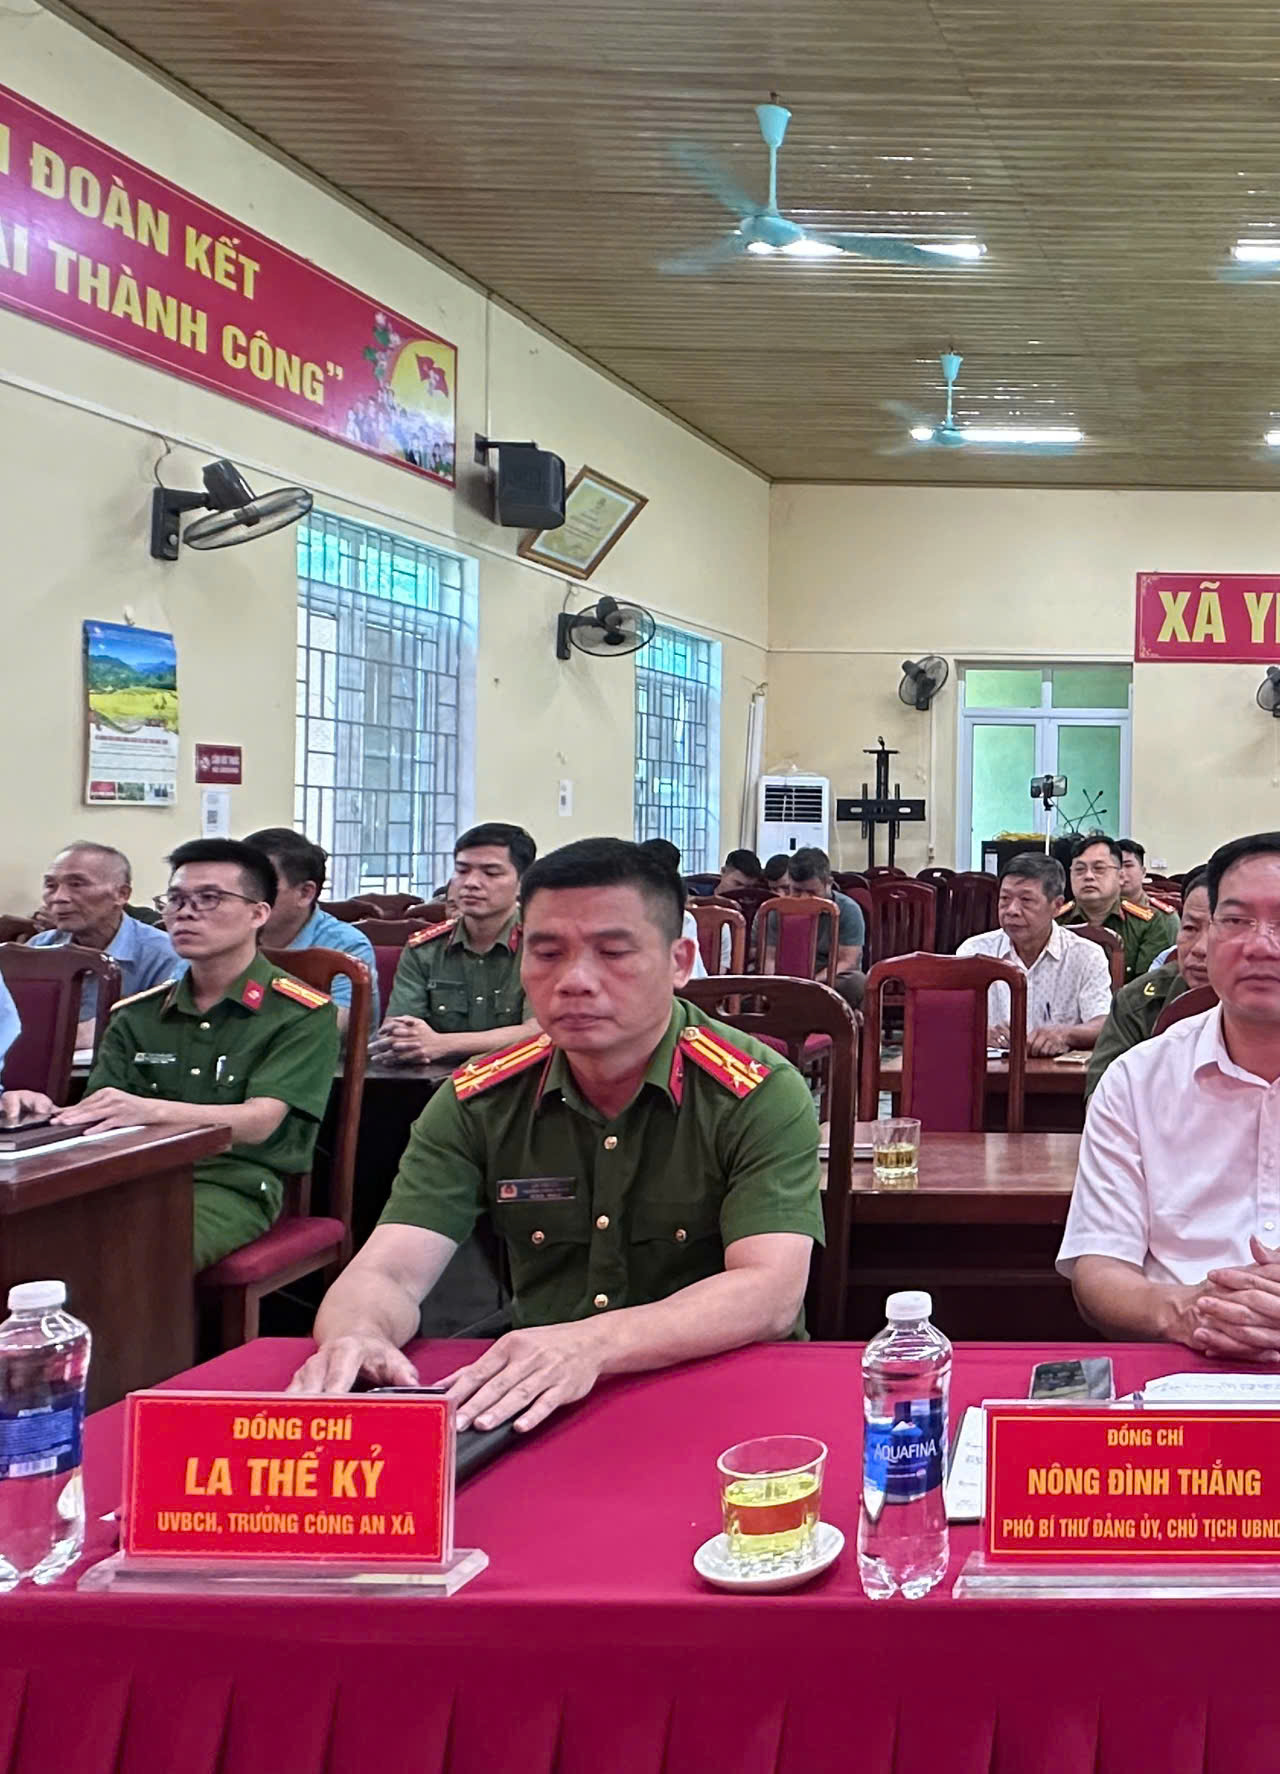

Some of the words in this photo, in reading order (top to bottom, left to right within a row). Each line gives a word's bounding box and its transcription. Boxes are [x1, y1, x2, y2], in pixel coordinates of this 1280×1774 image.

[30, 140, 170, 257] ĐOÀN
[185, 224, 261, 300] KẾT
[48, 239, 208, 354] THÀNH
[1156, 580, 1227, 644] XÃ
[310, 1413, 353, 1441] CHÍ
[1156, 1425, 1184, 1447] CHÍ
[874, 1438, 938, 1463] AQUAFINA
[184, 1457, 233, 1497] LA
[246, 1445, 324, 1498] THẾ
[332, 1444, 385, 1499] KỶ
[1027, 1461, 1100, 1497] NÔNG
[1107, 1462, 1171, 1496] ĐÌNH
[1177, 1459, 1262, 1497] THẮNG
[157, 1511, 223, 1535] UVBCH,
[227, 1504, 299, 1535] TRƯỞNG
[303, 1508, 354, 1536] CÔNG
[359, 1513, 386, 1536] AN
[390, 1510, 416, 1536] XÃ
[1002, 1513, 1034, 1539] PHÓ
[1038, 1514, 1055, 1539] BÍ
[1058, 1516, 1091, 1539] THƯ
[1092, 1512, 1135, 1539] ĐẢNG
[1140, 1512, 1163, 1542] ỦY,
[1167, 1512, 1199, 1539] CHỦ
[1203, 1517, 1238, 1542] TỊCH
